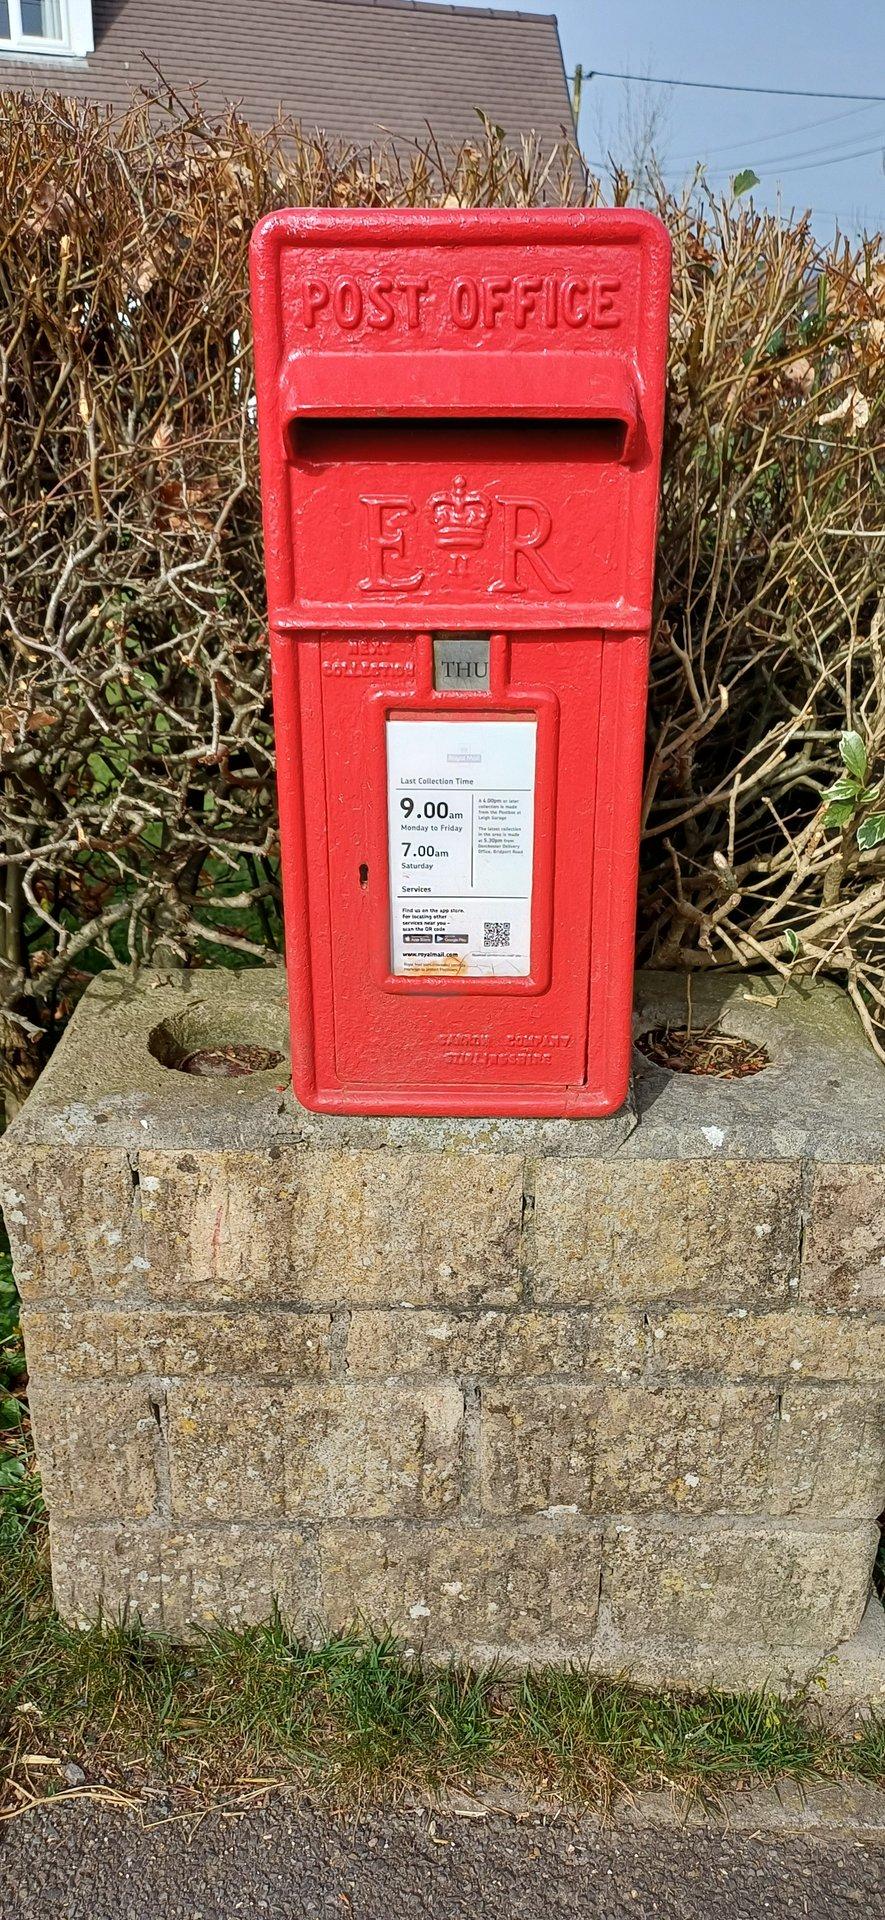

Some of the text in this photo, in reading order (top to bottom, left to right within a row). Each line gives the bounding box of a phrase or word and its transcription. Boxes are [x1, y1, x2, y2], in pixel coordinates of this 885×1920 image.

[301, 274, 622, 330] POST OFFICE
[441, 660, 489, 678] THU
[400, 777, 474, 785] Last Collection Time
[400, 797, 463, 819] 9.00am
[400, 824, 429, 833] Monday
[440, 825, 463, 833] Friday
[401, 842, 449, 857] 7.00am
[401, 862, 434, 870] Saturday
